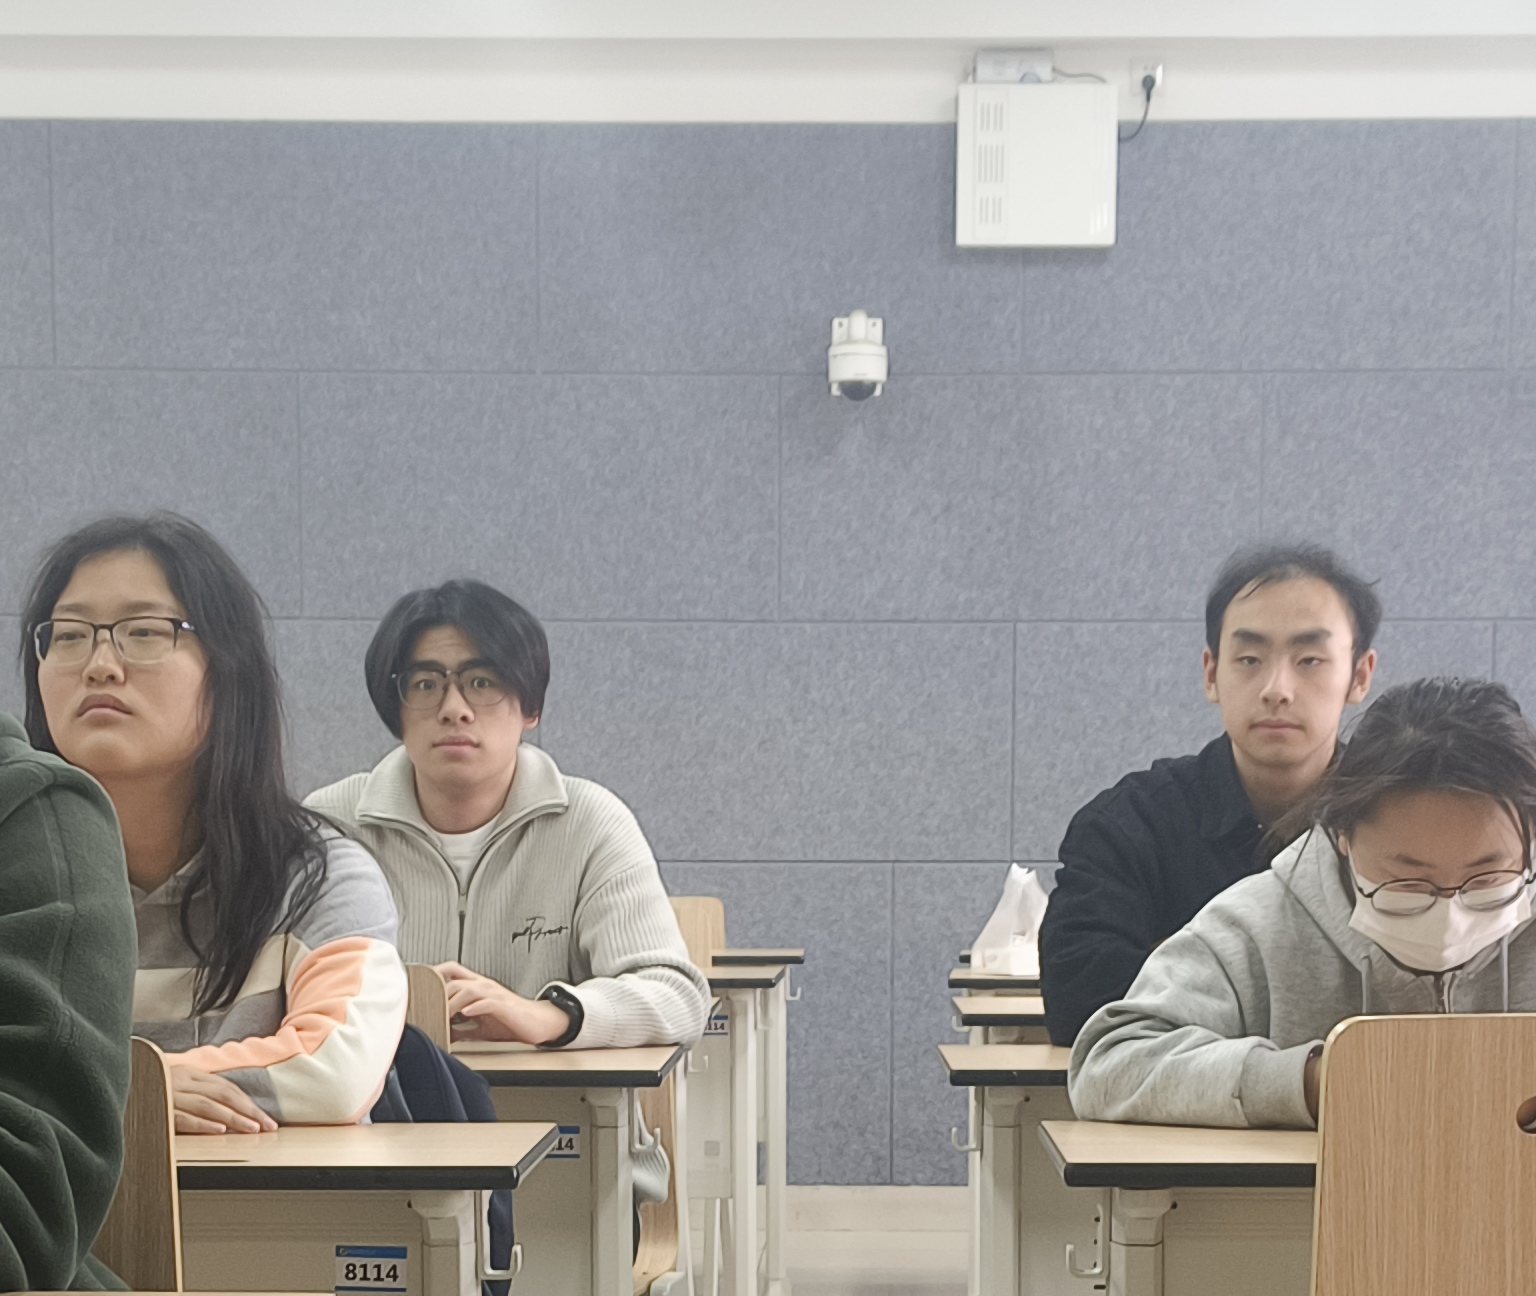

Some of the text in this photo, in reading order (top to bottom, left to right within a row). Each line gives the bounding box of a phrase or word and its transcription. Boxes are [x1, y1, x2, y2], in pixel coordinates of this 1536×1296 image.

[705, 1021, 725, 1031] 114
[551, 1136, 575, 1151] 14
[344, 1262, 400, 1283] 8114
